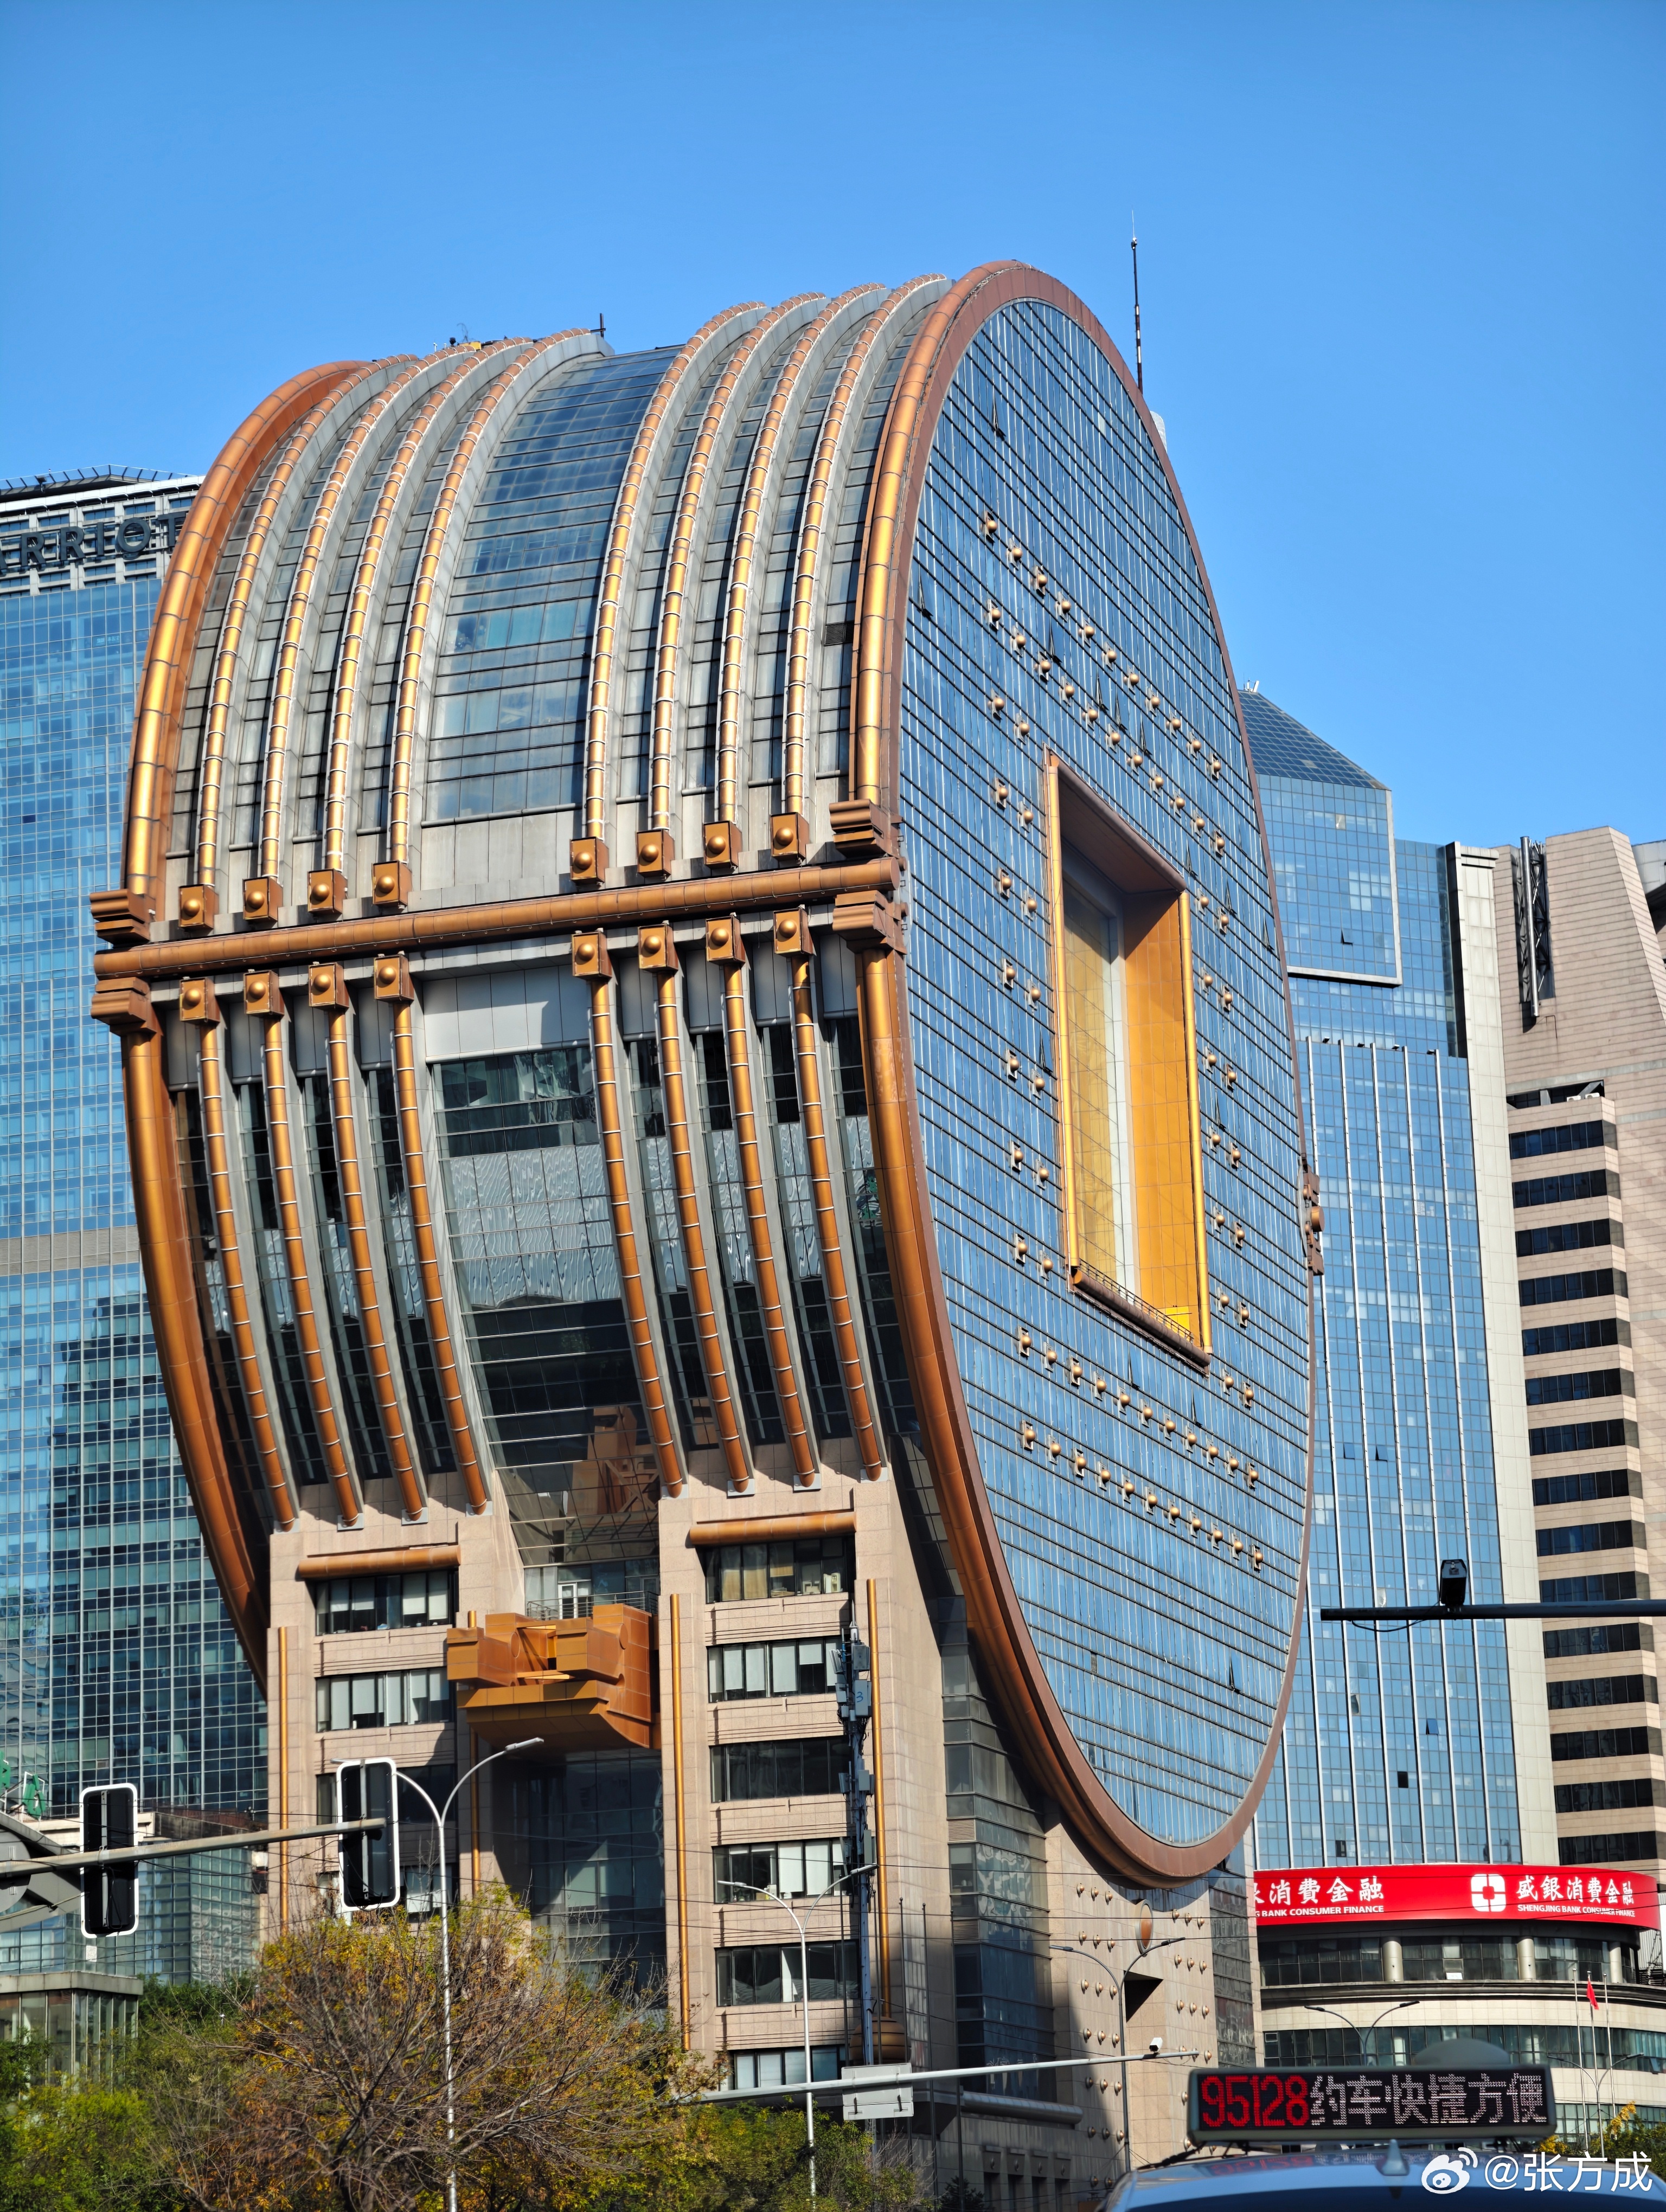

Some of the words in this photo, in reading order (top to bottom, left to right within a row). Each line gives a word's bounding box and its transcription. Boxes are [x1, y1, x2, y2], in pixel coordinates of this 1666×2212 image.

[0, 512, 189, 570] RRIOT
[856, 1691, 864, 1703] 3
[1261, 1909, 1287, 1917] BANK
[1289, 1907, 1342, 1916] CONSUMER
[1343, 1905, 1385, 1914] FINANCE
[1517, 1904, 1561, 1913] SHENGJING
[1561, 1905, 1582, 1913] BANK
[1582, 1906, 1616, 1915] CONSUMER
[1616, 1908, 1636, 1918] FINANCE
